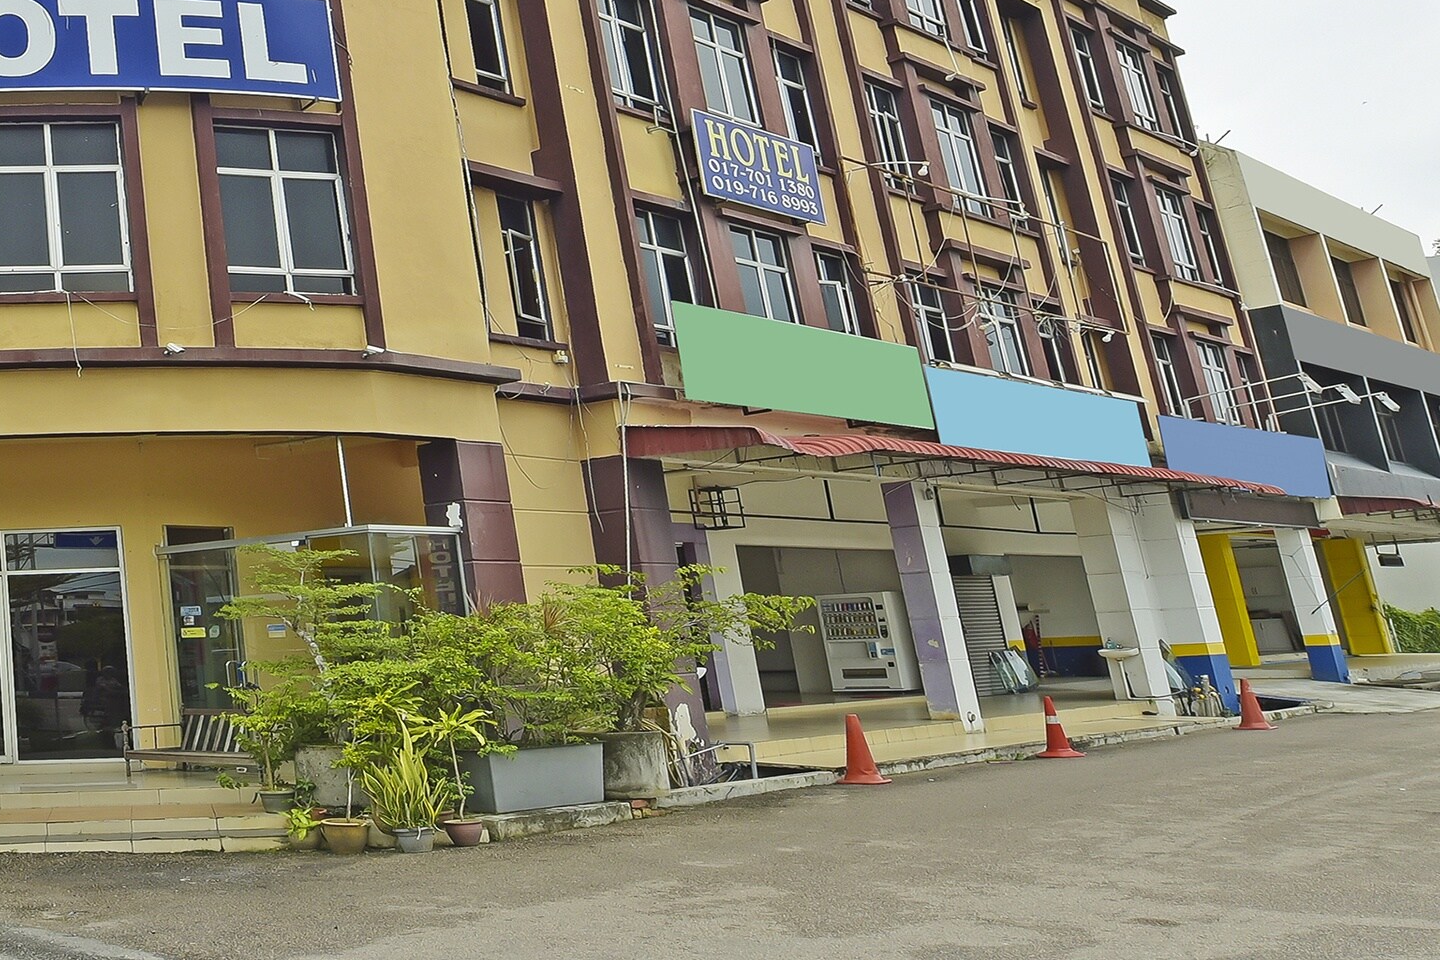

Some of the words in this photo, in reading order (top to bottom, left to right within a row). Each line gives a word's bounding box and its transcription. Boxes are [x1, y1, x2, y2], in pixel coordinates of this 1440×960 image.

[704, 119, 810, 185] HOTEL
[708, 158, 773, 188] 017-701
[779, 178, 815, 200] 1380
[712, 175, 778, 205] 019-716
[781, 195, 819, 216] 8993
